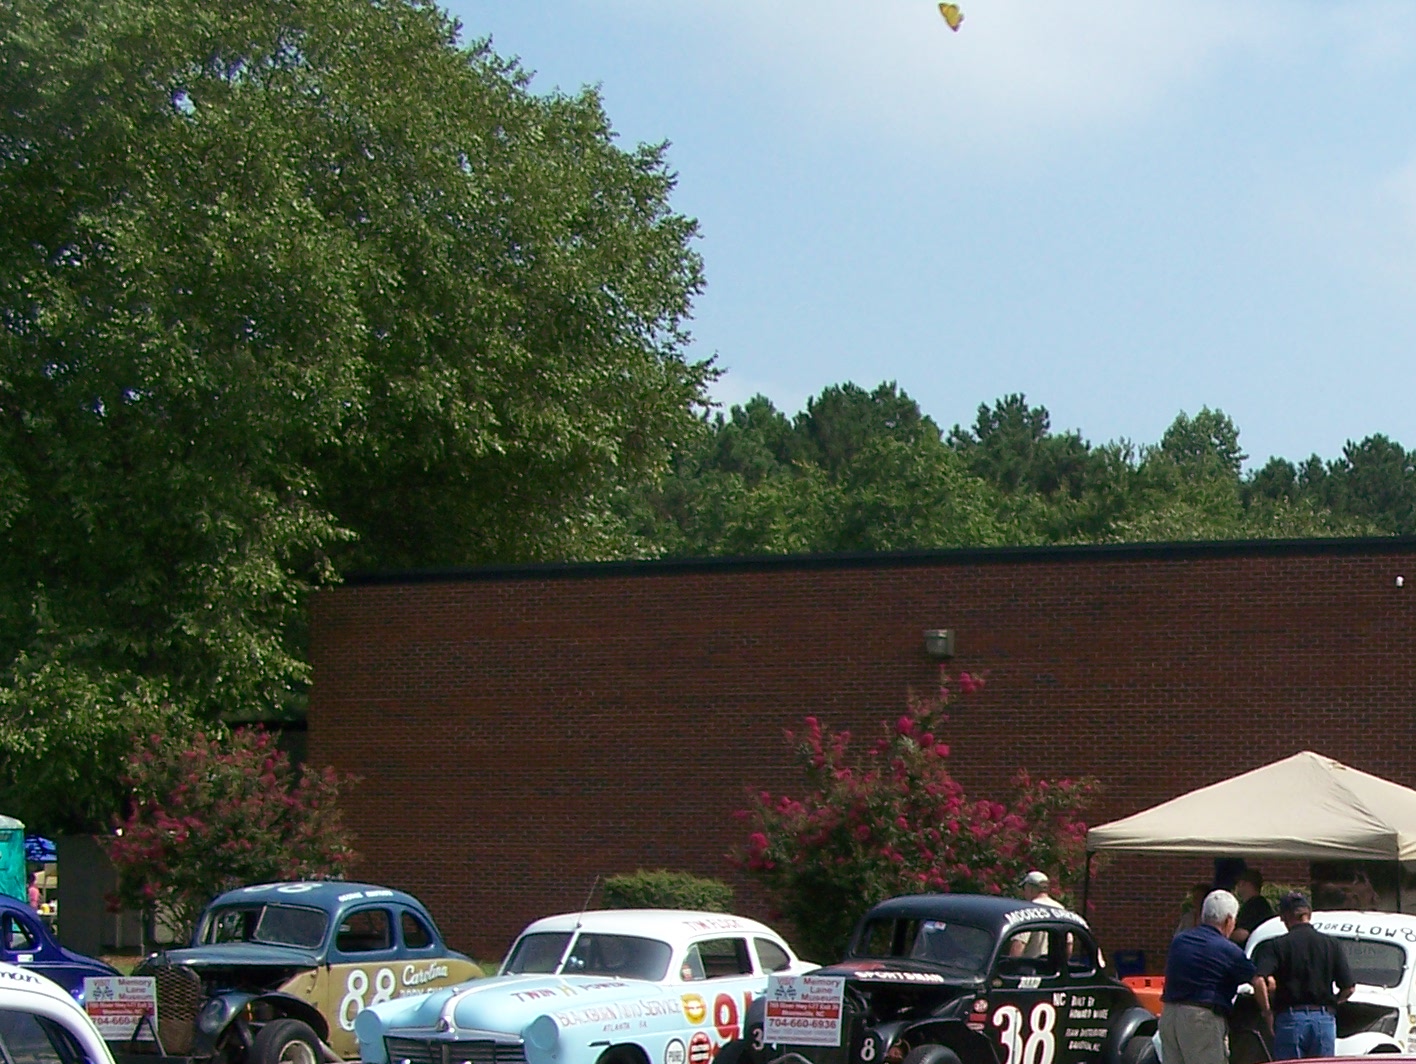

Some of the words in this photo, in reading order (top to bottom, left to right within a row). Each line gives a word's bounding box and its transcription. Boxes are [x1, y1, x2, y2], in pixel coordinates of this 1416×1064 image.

[1340, 924, 1397, 938] BLOW
[803, 978, 840, 987] Memory
[854, 971, 944, 983] SPORTSMAN
[511, 990, 556, 1002] TWIN
[556, 985, 577, 998] H
[809, 986, 833, 994] Lane
[338, 968, 396, 1031] 88
[1053, 992, 1066, 1007] NC
[639, 998, 682, 1017] SERVICE
[769, 1019, 837, 1029] 704-660-6936
[860, 1037, 875, 1061] 8
